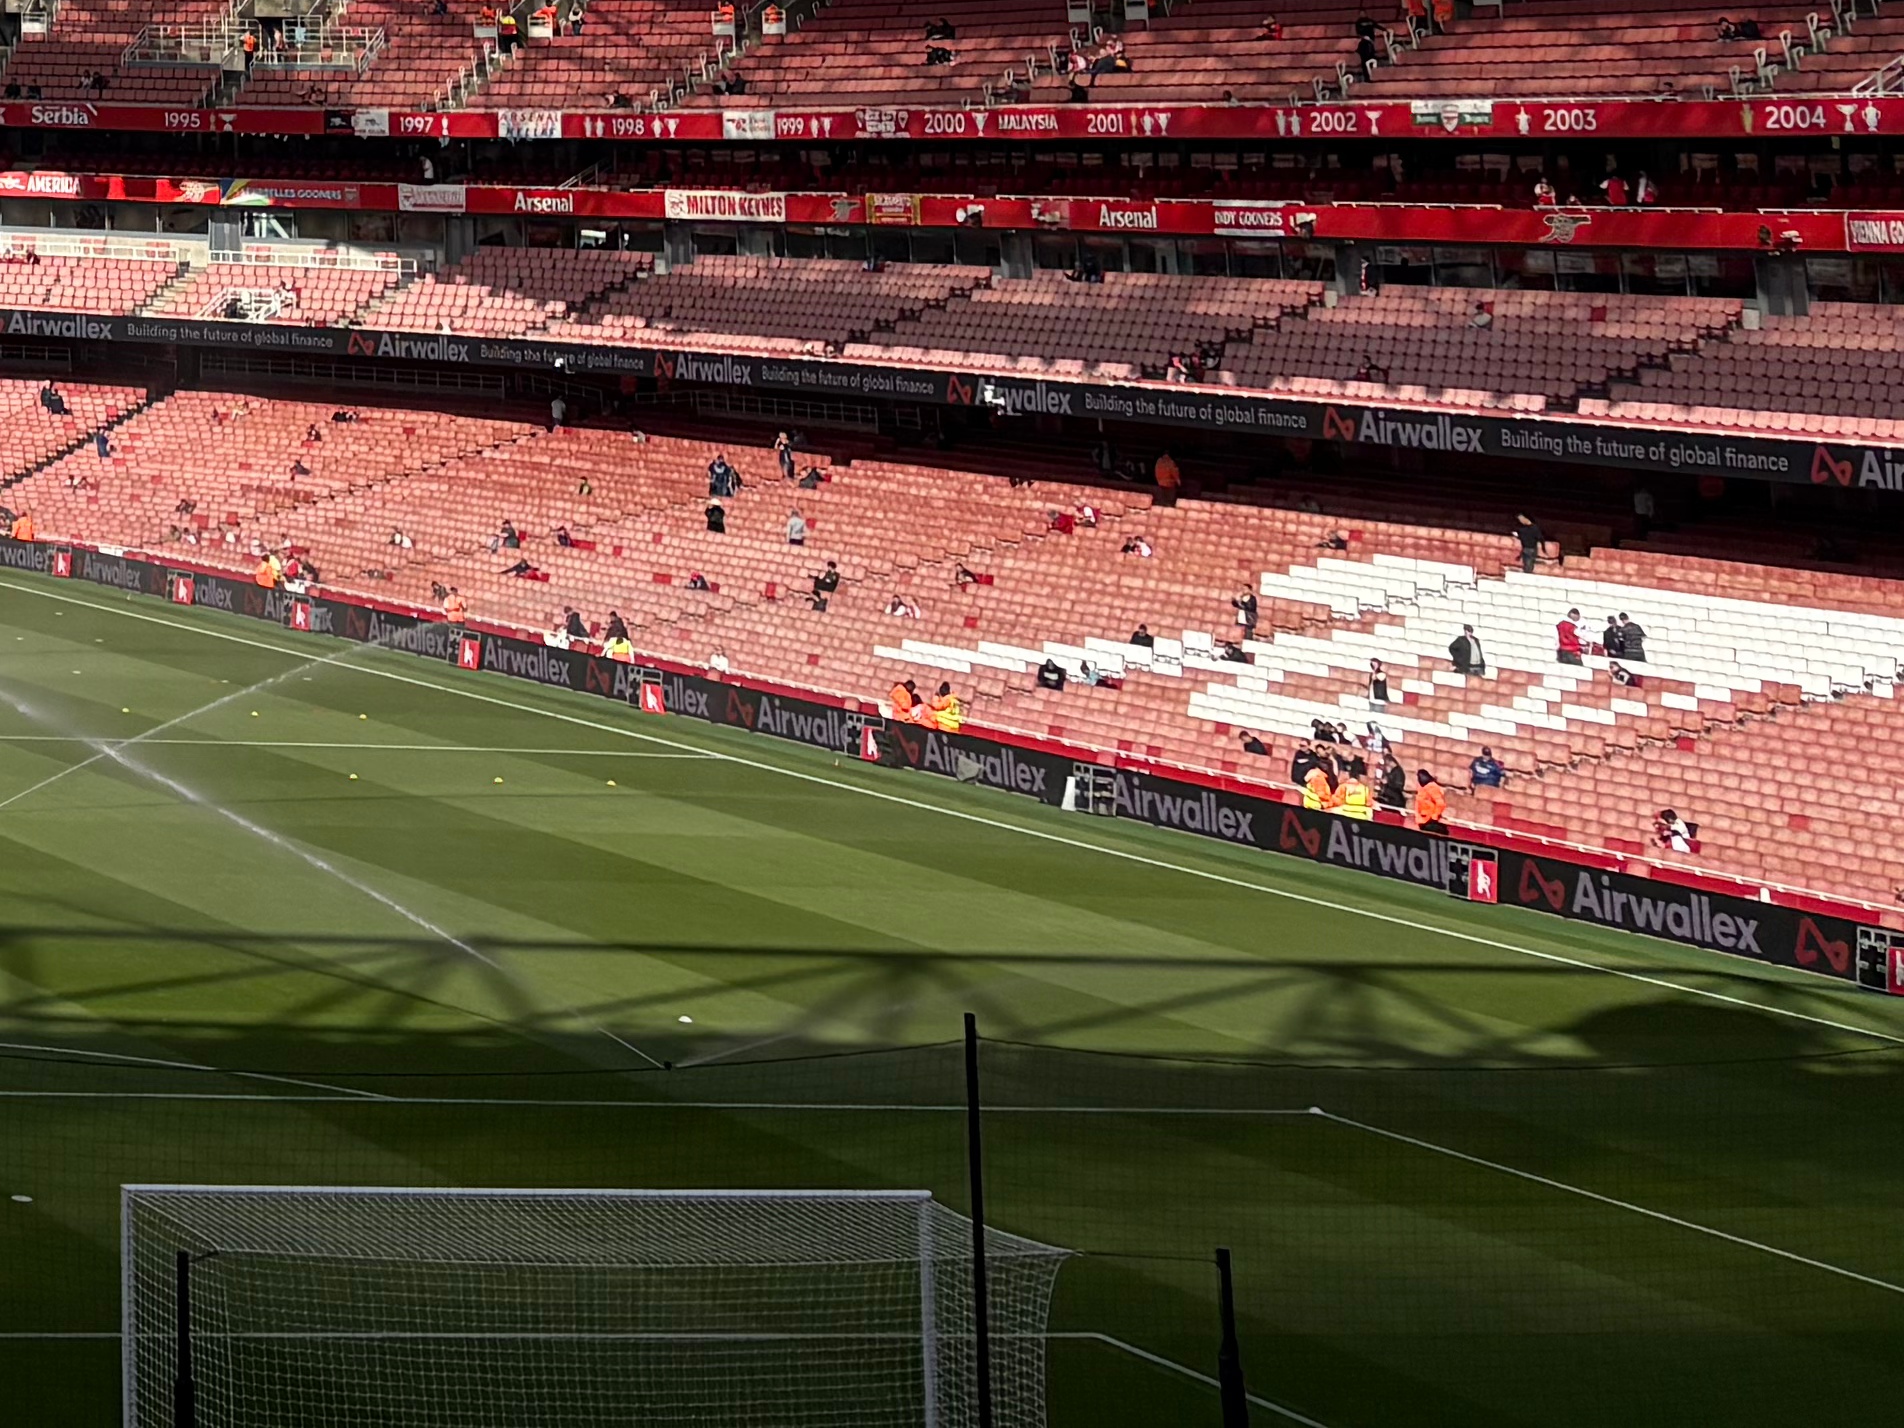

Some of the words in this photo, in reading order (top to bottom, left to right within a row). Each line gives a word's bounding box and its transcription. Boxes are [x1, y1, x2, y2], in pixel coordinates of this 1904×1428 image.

[30, 105, 89, 125] Serbia
[164, 111, 201, 128] 1995
[399, 116, 434, 132] 1997
[500, 111, 561, 123] ARSENAL
[612, 118, 645, 134] 1998
[777, 118, 804, 135] 1999
[924, 114, 965, 133] 2000
[998, 114, 1058, 131] MALAYSIA
[1087, 114, 1124, 133] 2001
[1310, 111, 1357, 132] 2002
[1543, 108, 1597, 132] 2003
[1765, 106, 1826, 130] 2004
[27, 175, 81, 195] AMERICA
[515, 192, 573, 212] Arsenal
[686, 194, 738, 217] MILTON
[741, 196, 783, 218] KEYNES
[1100, 205, 1157, 228] Arsenal
[8, 312, 112, 340] Airwallex
[377, 334, 469, 363] Airwallex
[675, 353, 752, 385] Airwallex
[1084, 393, 1133, 415] Building
[1135, 398, 1156, 415] the
[1158, 400, 1196, 420] future
[1199, 403, 1213, 421] of
[1216, 404, 1256, 426] global
[1258, 409, 1307, 429] finance
[1358, 410, 1485, 453] Airwallex
[1501, 428, 1564, 456] Building
[1566, 434, 1592, 455] the
[1596, 438, 1645, 460] future
[1649, 441, 1666, 461] of
[1669, 442, 1721, 468] global
[1725, 450, 1788, 472] finance
[83, 553, 141, 589] Airwallex
[485, 636, 571, 685] Airwallex
[1114, 773, 1256, 842] Airwallex
[1327, 819, 1448, 884] Airwall
[1572, 872, 1764, 955] Airwallex
